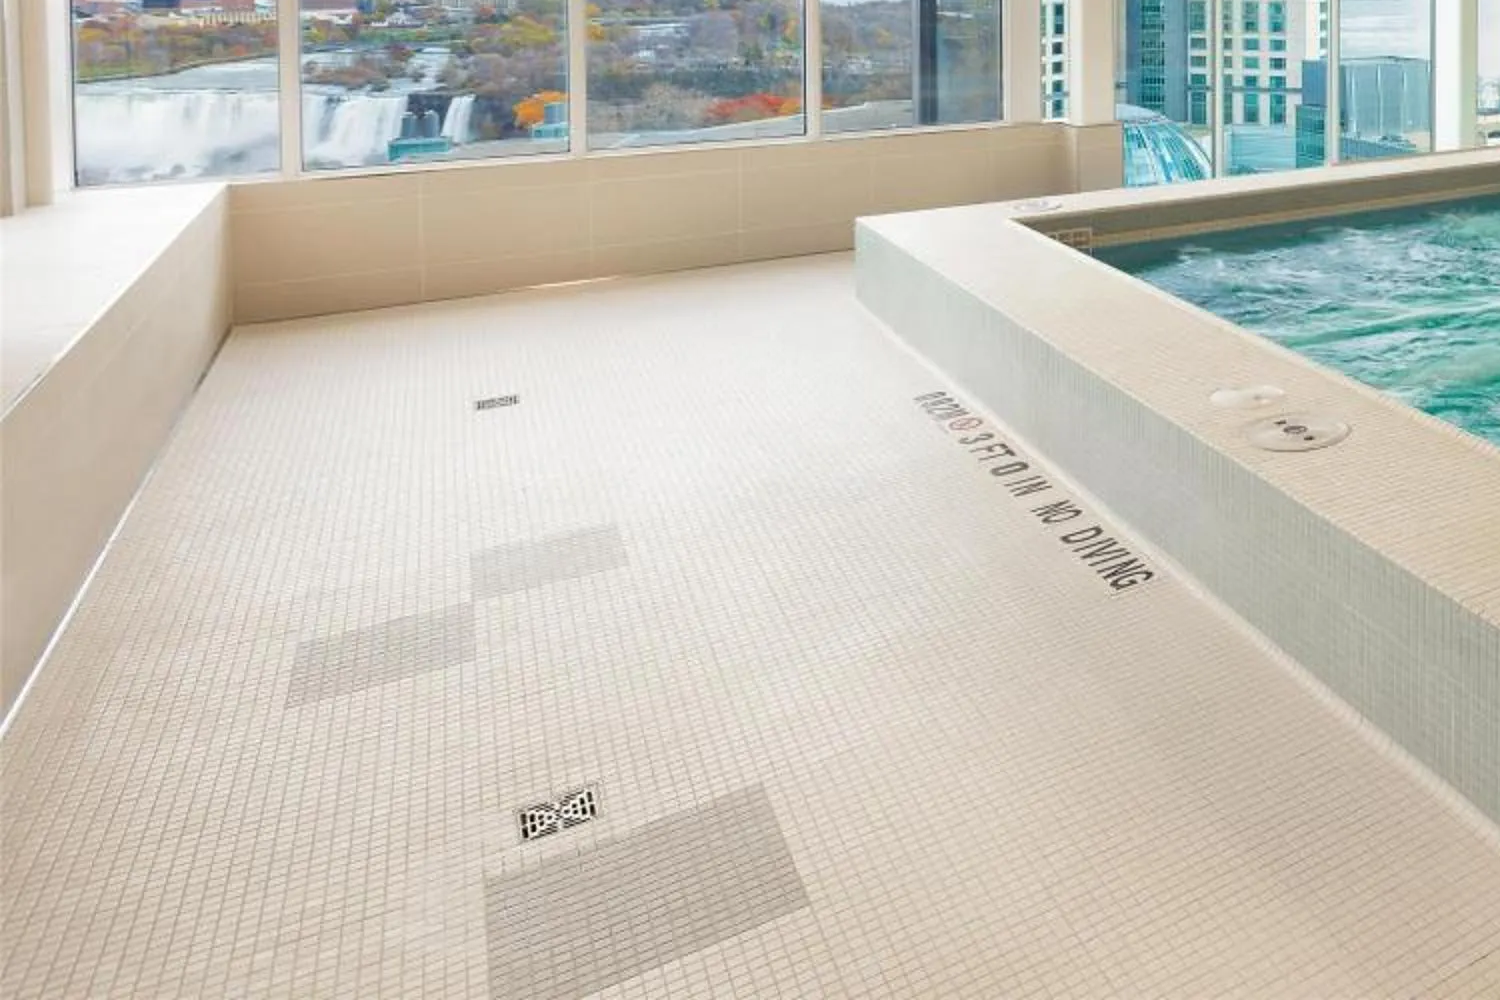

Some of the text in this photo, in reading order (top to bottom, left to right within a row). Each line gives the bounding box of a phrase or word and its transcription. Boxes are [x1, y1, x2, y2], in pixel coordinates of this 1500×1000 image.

[958, 433, 994, 444] 3
[969, 443, 1016, 461] FT
[1004, 475, 1052, 497] IN
[1030, 499, 1083, 525] NO
[1060, 525, 1154, 591] DIVING
